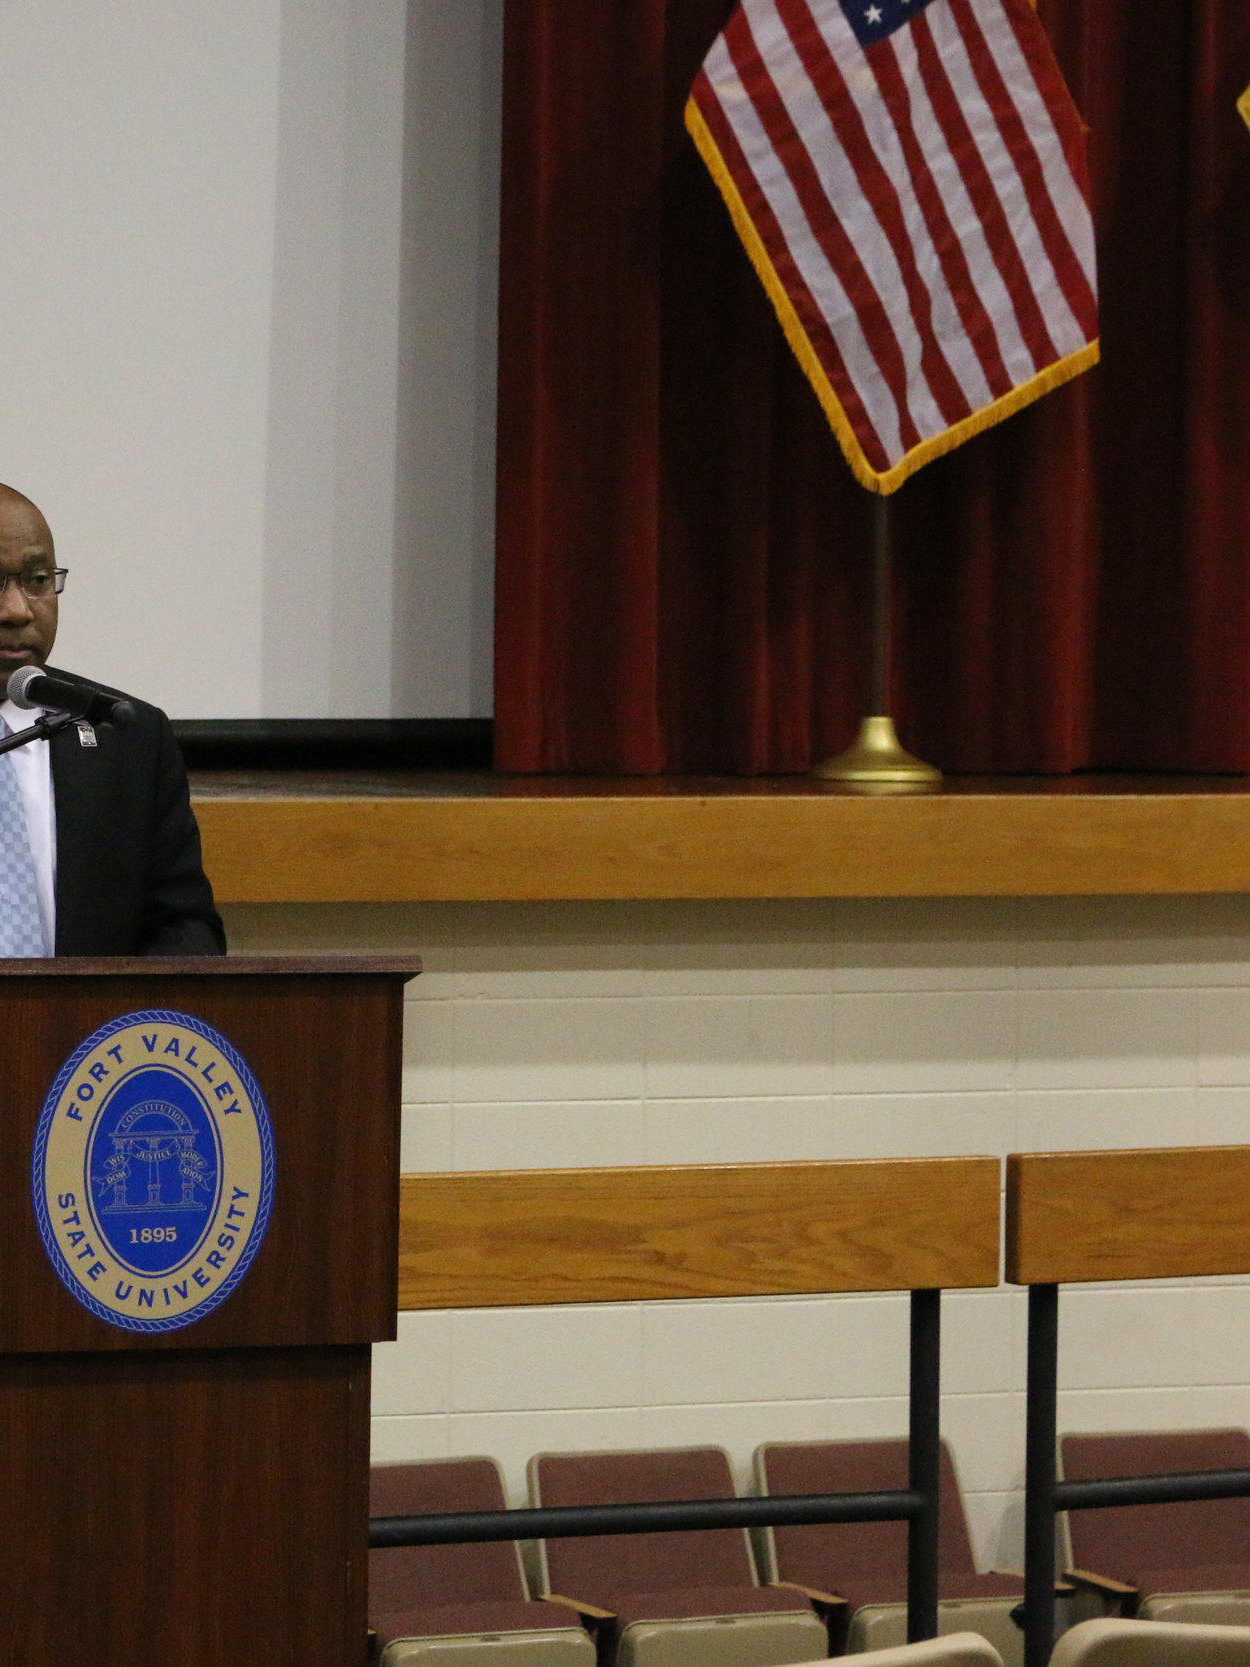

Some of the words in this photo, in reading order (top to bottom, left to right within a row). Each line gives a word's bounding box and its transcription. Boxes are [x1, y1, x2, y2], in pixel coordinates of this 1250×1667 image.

[66, 1044, 125, 1122] FORT
[142, 1034, 242, 1117] VALLEY
[121, 1103, 186, 1128] CONSTITUTION
[136, 1150, 171, 1160] JUSTICE
[106, 1170, 126, 1184] DOM
[129, 1227, 177, 1244] 1895
[58, 1192, 107, 1282] STATE
[115, 1187, 250, 1307] UNIVERSITY
